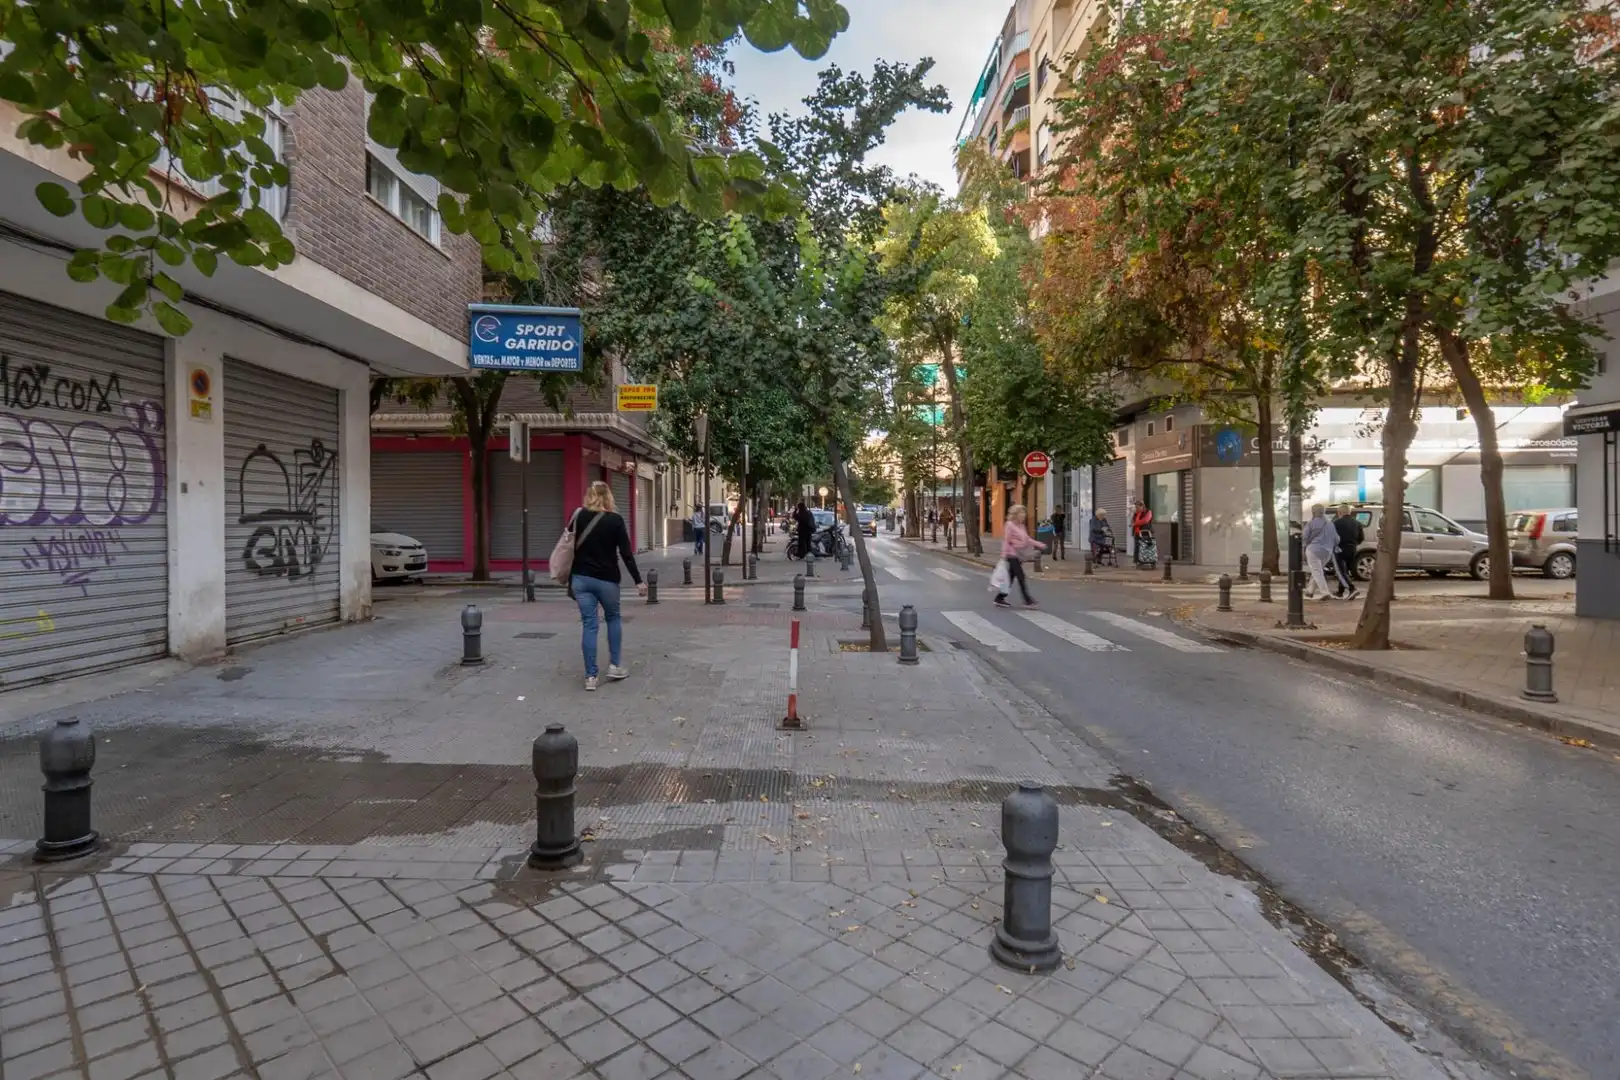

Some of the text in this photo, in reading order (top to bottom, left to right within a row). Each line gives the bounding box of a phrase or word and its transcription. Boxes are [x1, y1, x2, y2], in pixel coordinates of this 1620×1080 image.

[515, 324, 565, 337] SPORT
[505, 337, 574, 351] GARRIDO
[473, 354, 494, 365] VENTAS
[501, 355, 520, 366] MAYOR
[525, 356, 544, 367] MENOR
[551, 357, 577, 368] DEPORTES
[1572, 421, 1610, 431] VICTORIA
